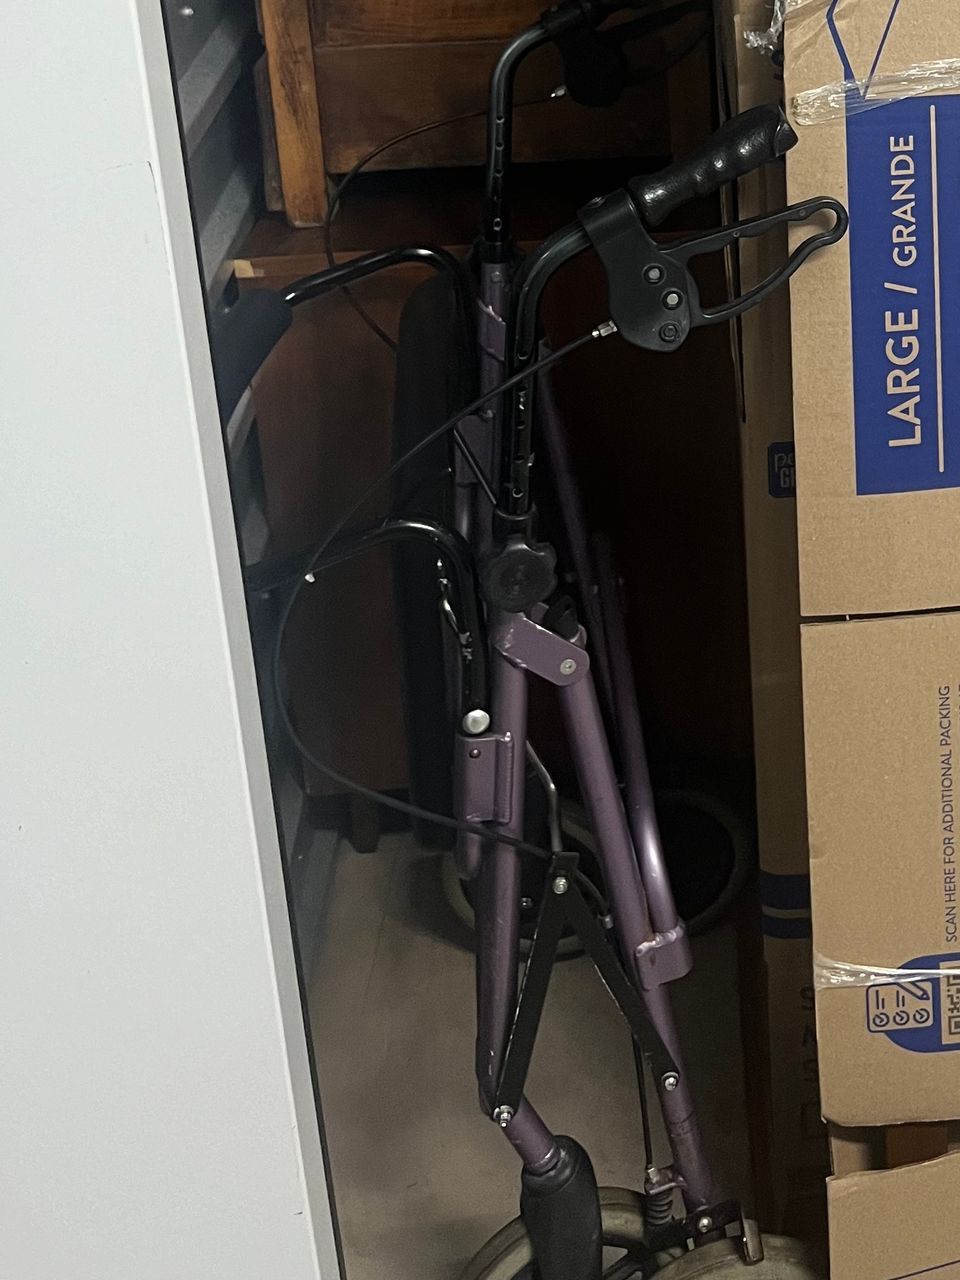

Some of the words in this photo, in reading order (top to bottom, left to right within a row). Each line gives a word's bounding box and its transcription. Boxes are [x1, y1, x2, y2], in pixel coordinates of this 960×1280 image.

[889, 135, 917, 267] GRANDE
[884, 282, 918, 294] /
[884, 308, 921, 447] LARGE
[938, 685, 951, 745] PACKING
[941, 749, 954, 833] ADDITIONAL
[943, 837, 955, 864] FOR
[944, 868, 956, 904] HERE
[946, 905, 957, 943] SCAN
